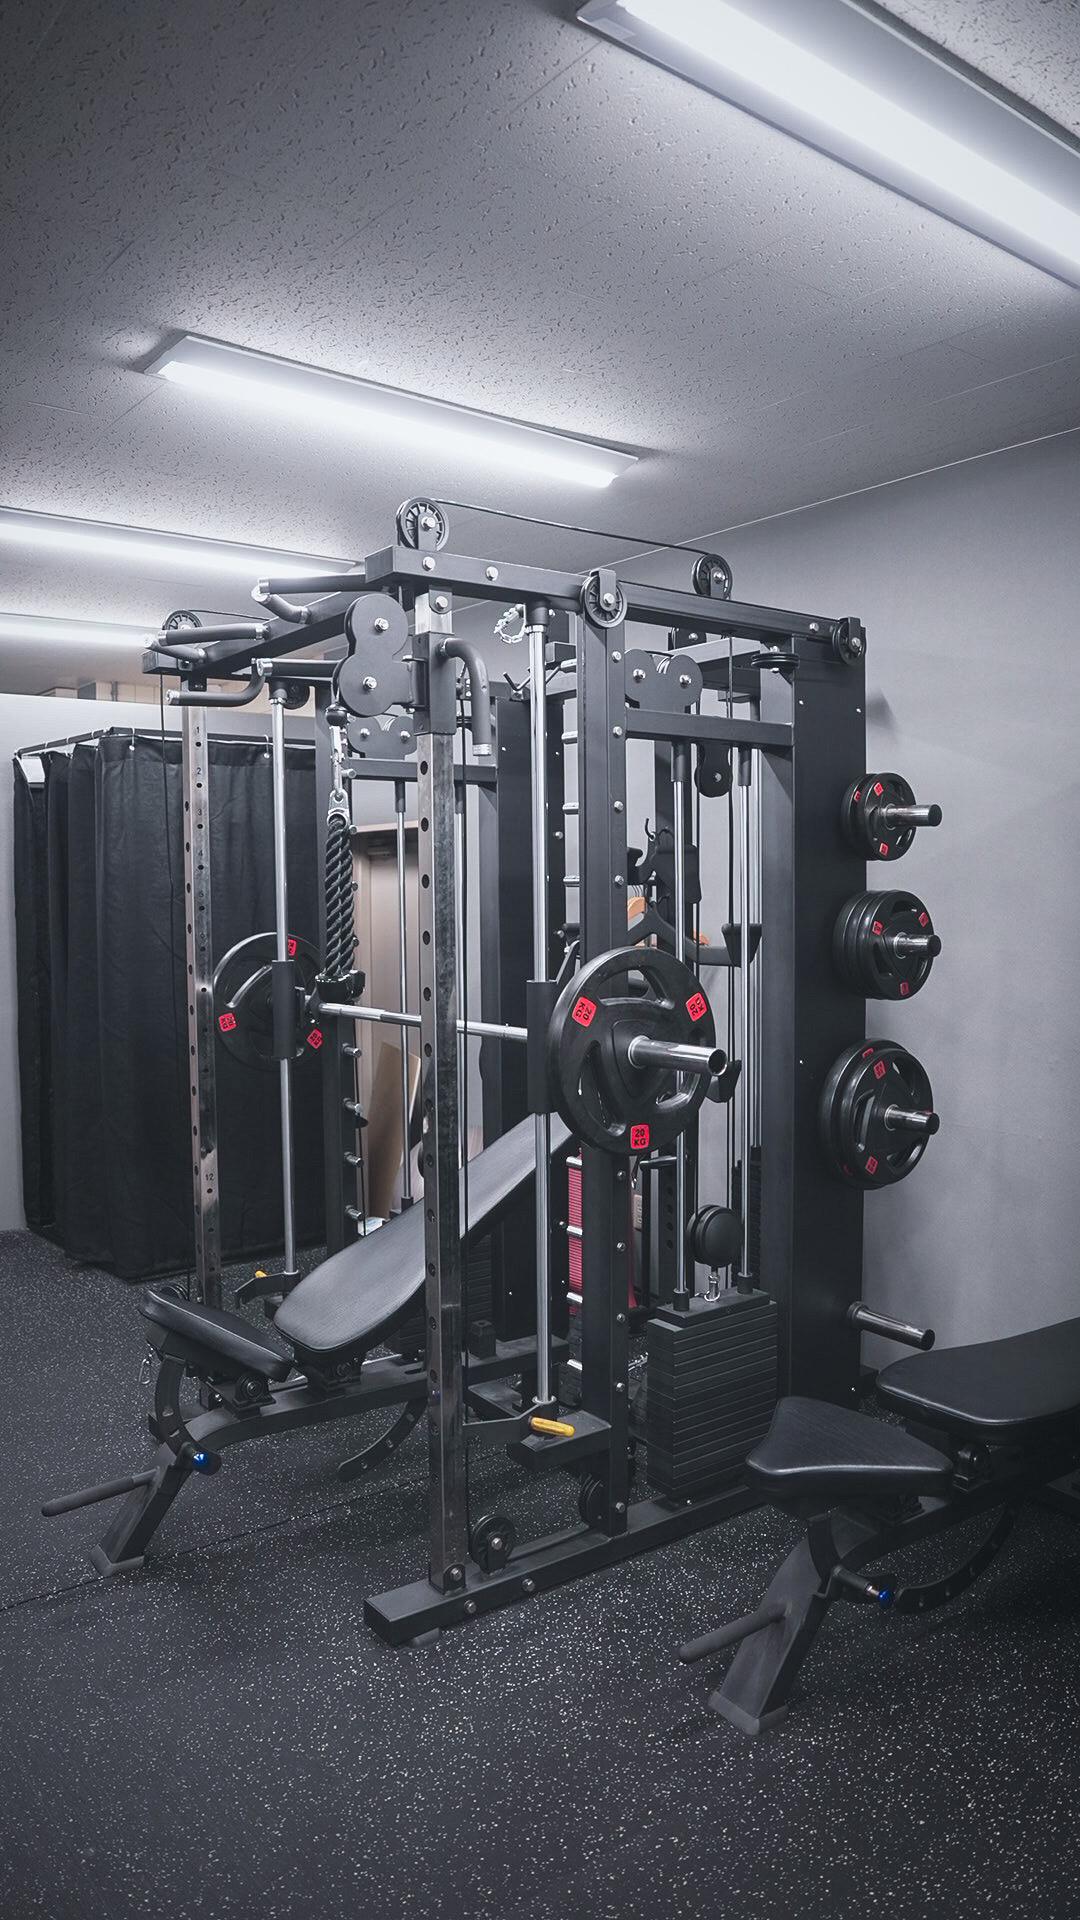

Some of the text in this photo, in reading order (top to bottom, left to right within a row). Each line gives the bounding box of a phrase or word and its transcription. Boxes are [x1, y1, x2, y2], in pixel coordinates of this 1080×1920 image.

[196, 768, 202, 776] 2
[695, 997, 704, 1011] KG
[576, 1002, 585, 1018] KG
[583, 1006, 592, 1020] 20
[690, 1004, 698, 1016] 20
[635, 1128, 645, 1137] 20
[634, 1138, 646, 1146] KG
[206, 1173, 214, 1181] 12
